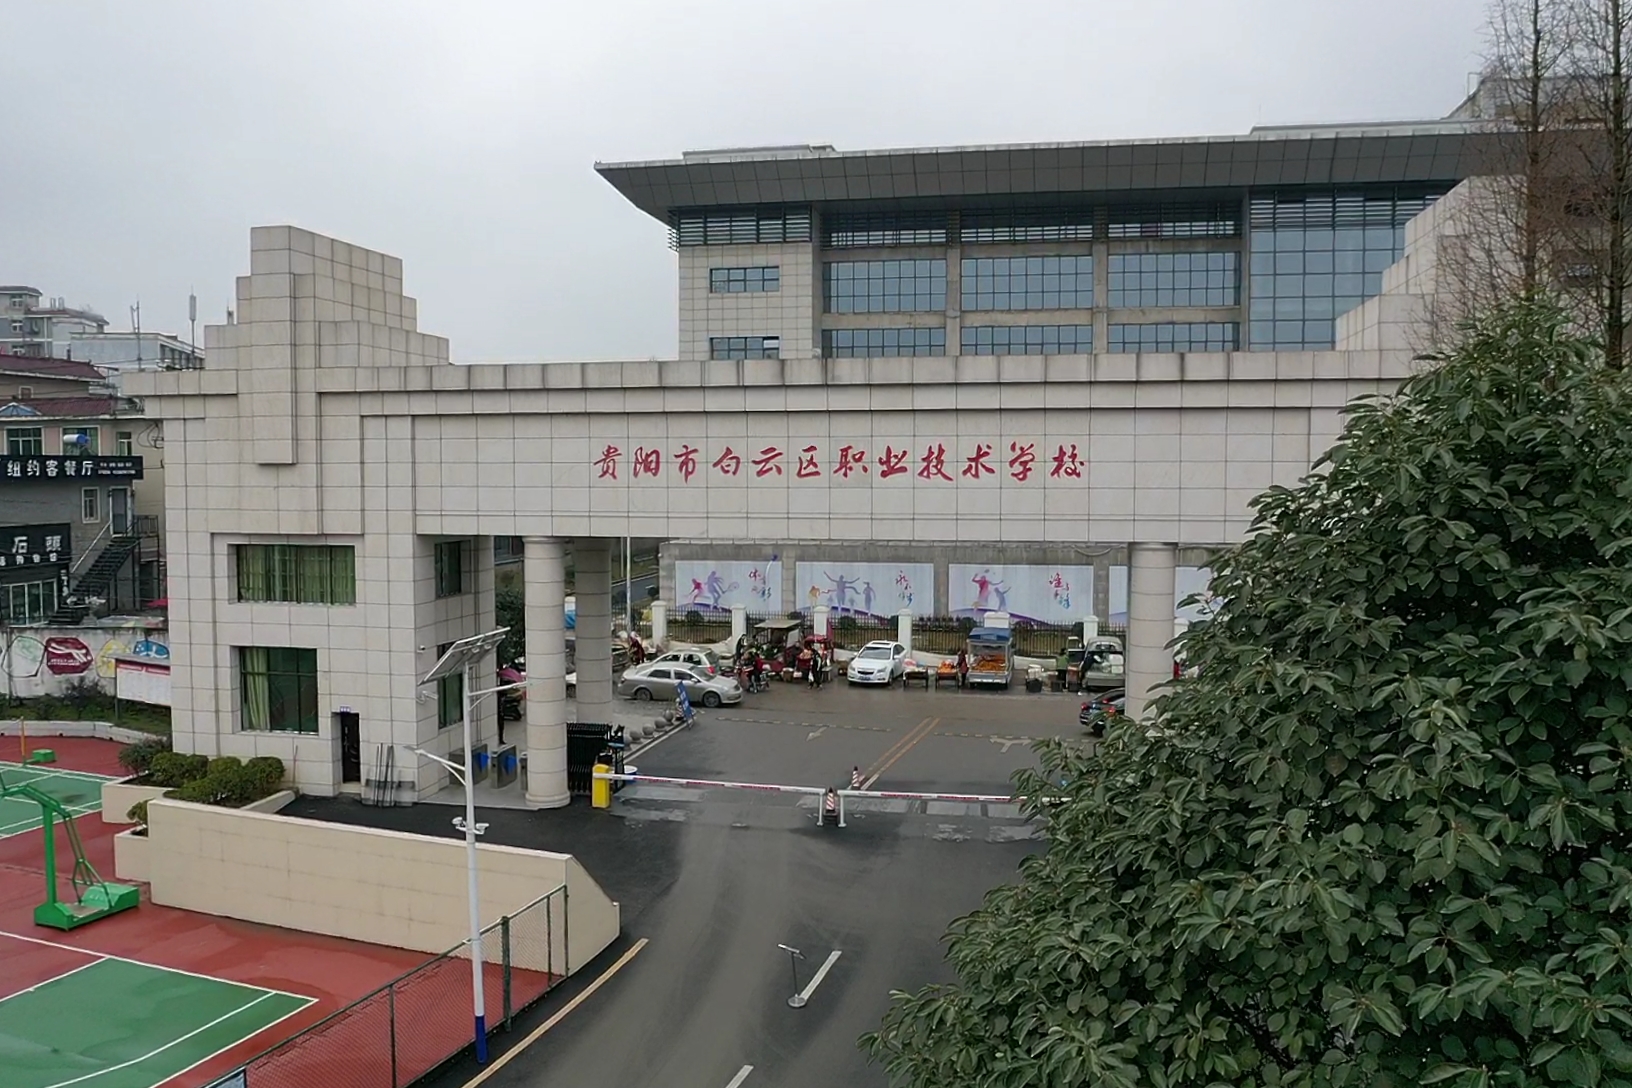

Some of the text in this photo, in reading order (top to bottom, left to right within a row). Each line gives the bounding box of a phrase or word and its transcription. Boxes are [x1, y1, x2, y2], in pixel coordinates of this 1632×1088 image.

[6, 459, 94, 477] 纽约客餐厅
[592, 442, 1085, 484] 贵阳市白云区职业技术学校
